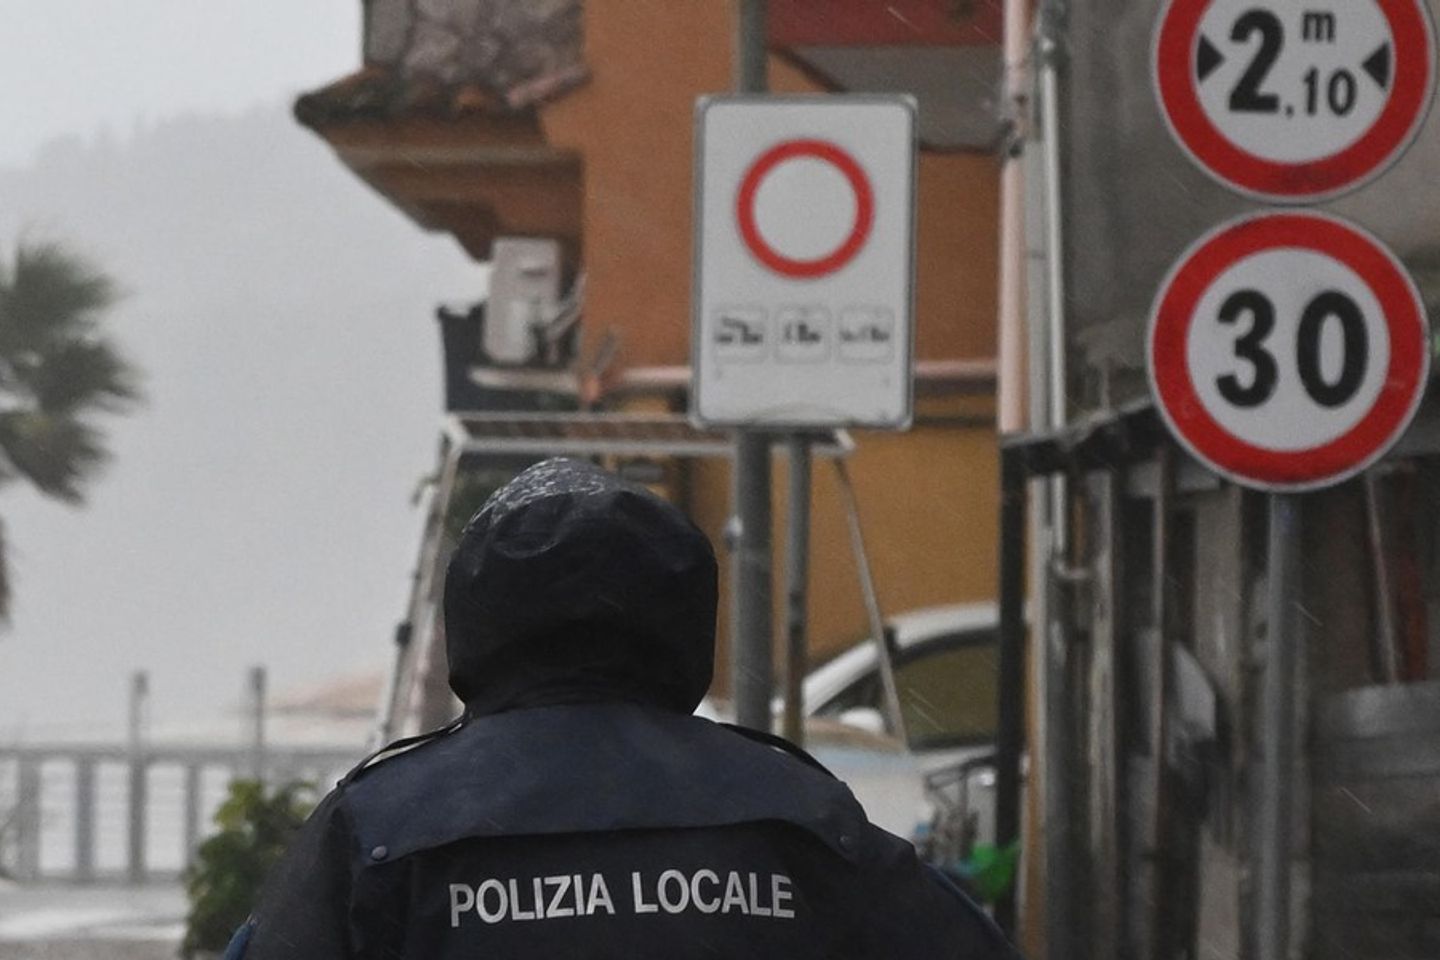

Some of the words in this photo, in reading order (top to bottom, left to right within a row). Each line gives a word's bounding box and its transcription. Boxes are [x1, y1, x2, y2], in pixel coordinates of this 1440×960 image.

[1301, 11, 1337, 43] m
[1215, 287, 1369, 410] 30
[449, 873, 616, 928] POLIZIA
[631, 868, 796, 919] LOCALE
